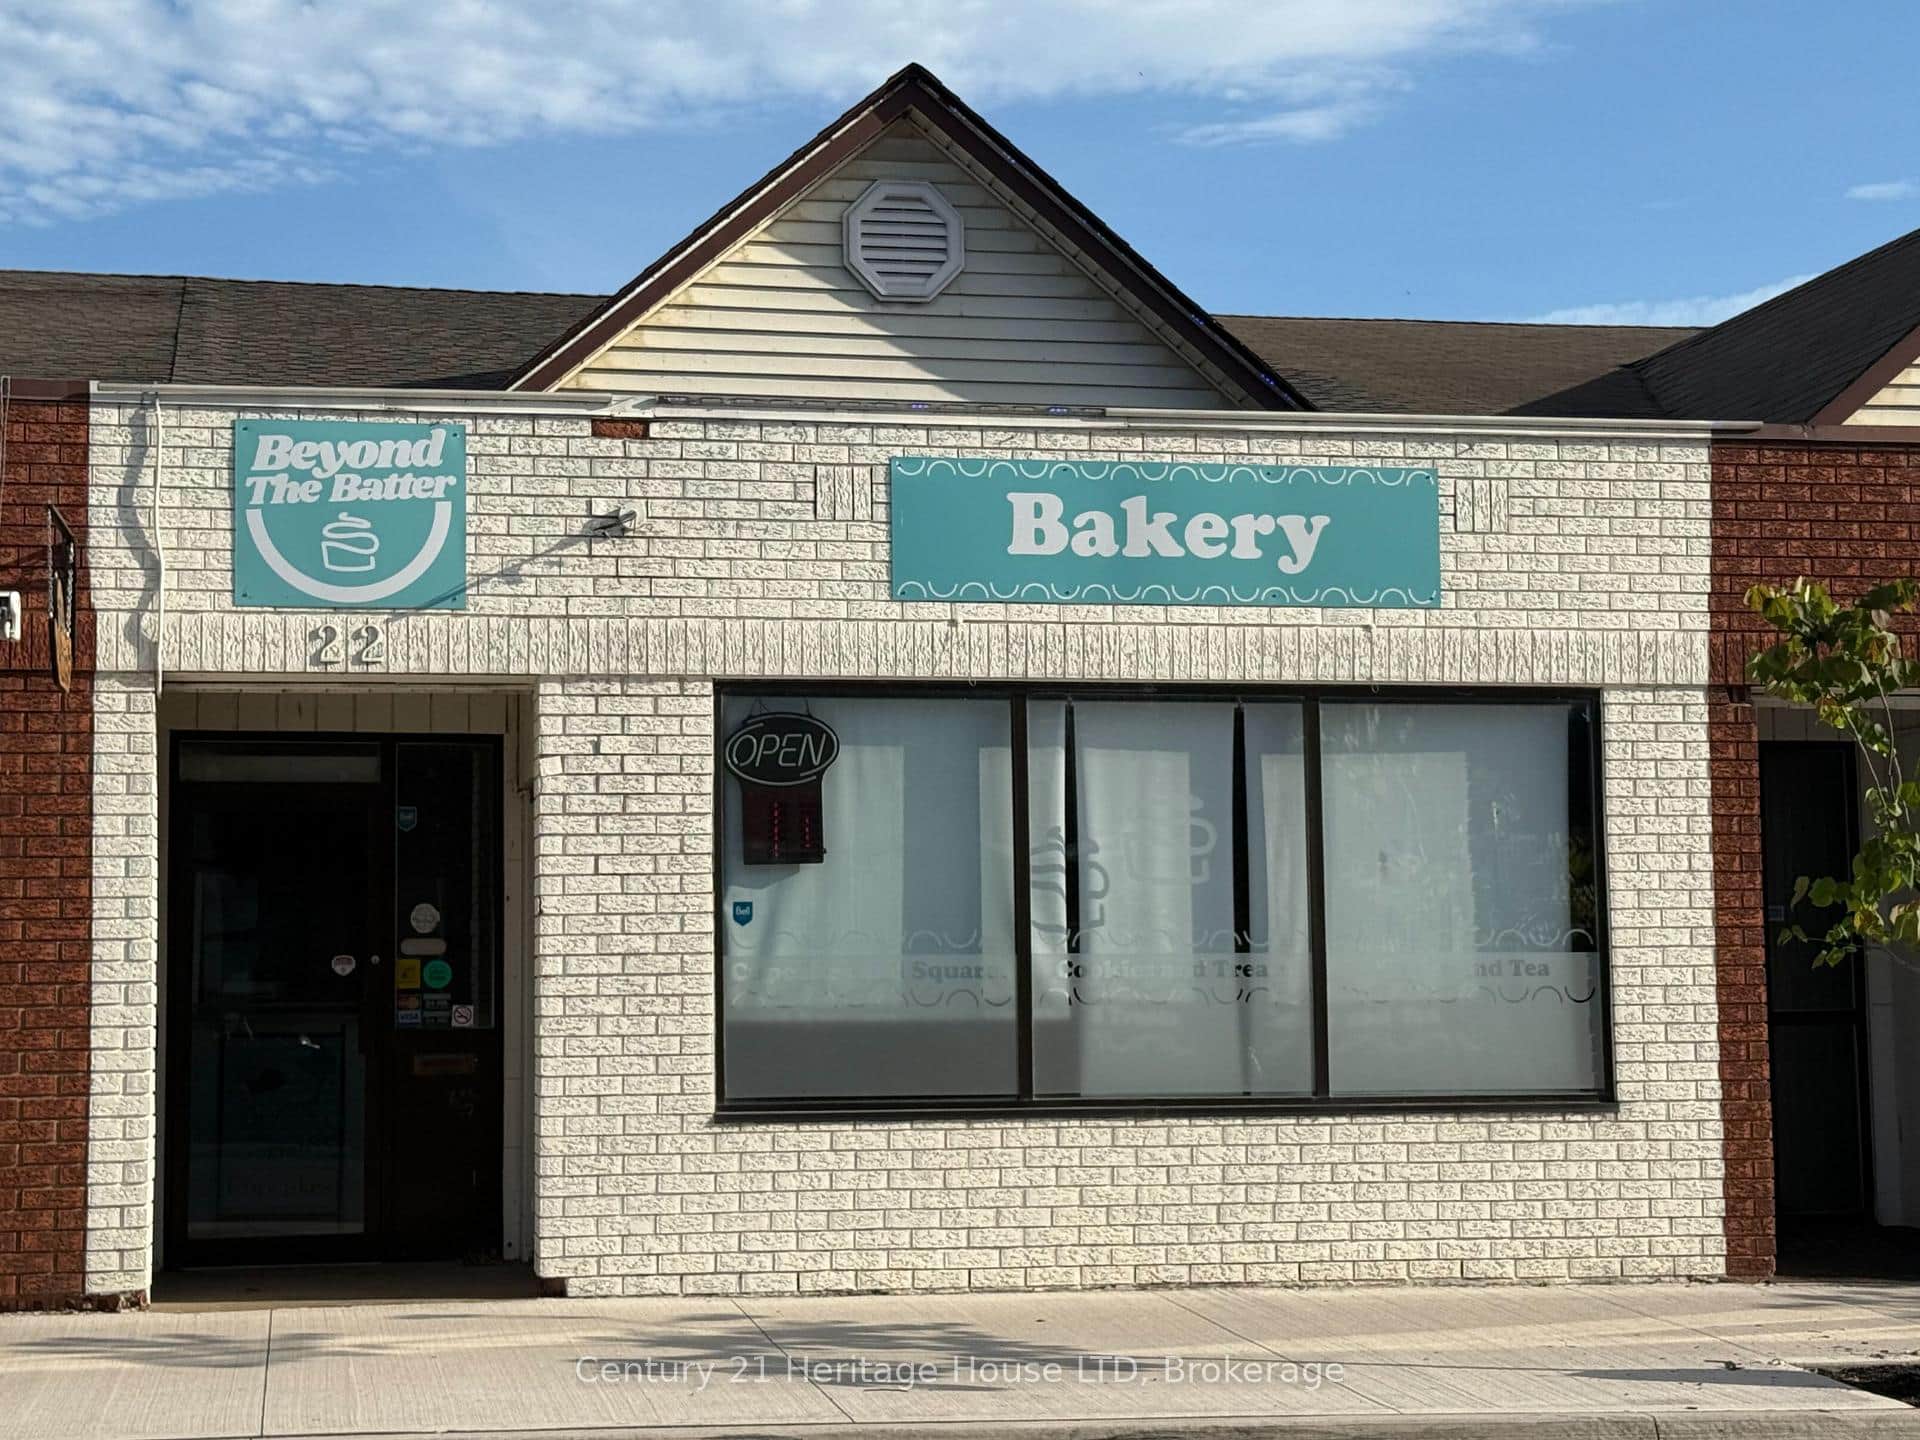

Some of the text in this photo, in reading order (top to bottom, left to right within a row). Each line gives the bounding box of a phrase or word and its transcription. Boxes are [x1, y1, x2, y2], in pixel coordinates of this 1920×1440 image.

[251, 428, 447, 480] Beyond
[245, 472, 457, 505] The Batter
[1006, 492, 1331, 575] Bakery
[317, 624, 386, 664] 22
[732, 732, 827, 767] OPEN
[1509, 959, 1550, 977] Tea
